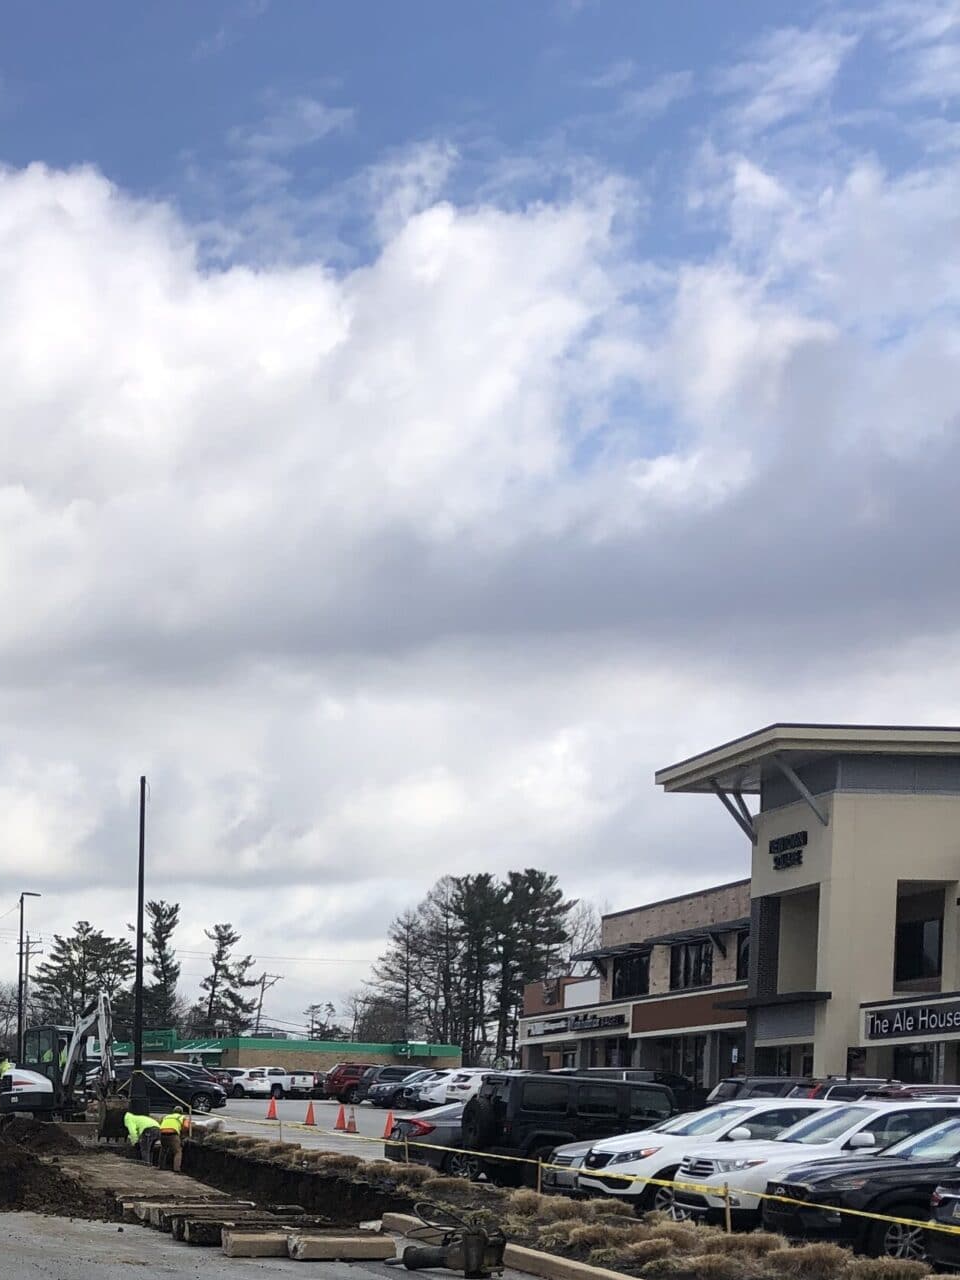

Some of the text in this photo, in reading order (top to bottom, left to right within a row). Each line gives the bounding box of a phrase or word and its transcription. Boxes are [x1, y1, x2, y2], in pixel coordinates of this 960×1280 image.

[867, 1008, 960, 1034] The Ale House
